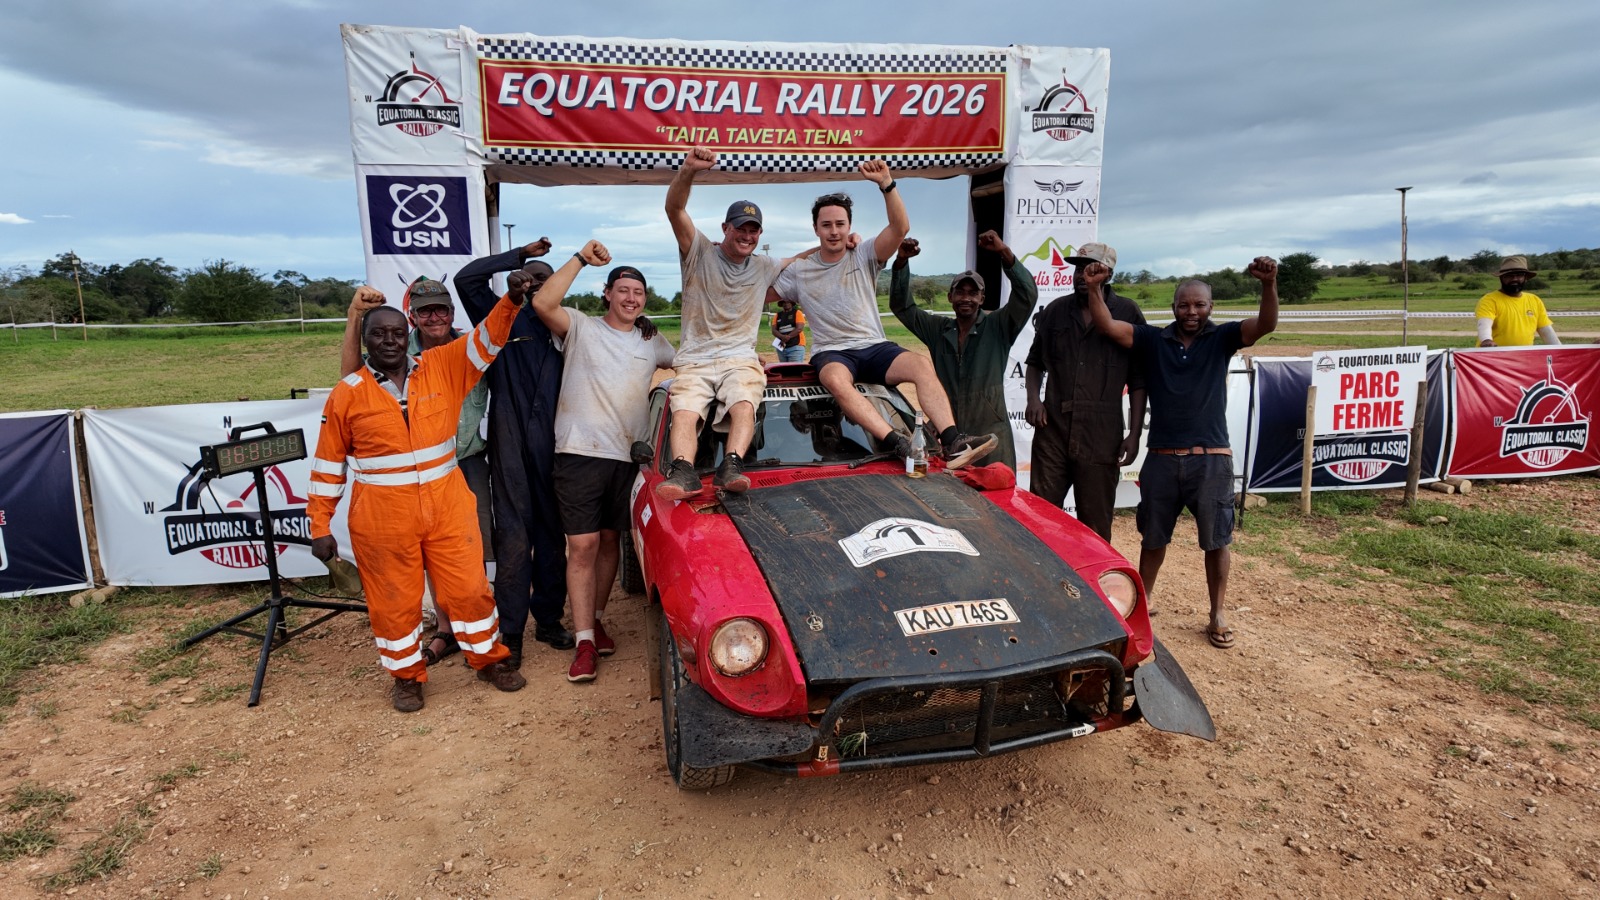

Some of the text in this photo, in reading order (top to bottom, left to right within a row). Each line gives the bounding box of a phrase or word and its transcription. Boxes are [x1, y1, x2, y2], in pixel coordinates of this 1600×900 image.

[364, 95, 372, 103] W
[498, 72, 987, 116] EQUATORIAL RALLY 2026
[378, 108, 459, 124] EQUATORIAL CLASSIC
[1033, 116, 1094, 130] EQUATORIAL CLASSIC
[402, 123, 439, 136] RALLYING
[726, 128, 798, 144] TAVETA
[1051, 129, 1078, 141] RALLYING
[392, 231, 451, 248] USN
[1338, 354, 1394, 368] EQUATORIAL
[1396, 352, 1421, 365] RALLY
[1340, 370, 1400, 400] PARC
[223, 415, 232, 428] N
[1333, 400, 1404, 431] FERME
[1505, 429, 1586, 451] EQUATORIAL CLASSIC
[1370, 440, 1407, 458] CLASSIC
[1527, 449, 1565, 466] RALLYING
[1337, 461, 1382, 479] RALLYING
[143, 501, 155, 515] W
[167, 516, 312, 550] EQUATORIAL CASSIC
[897, 527, 926, 546] 1
[903, 601, 1009, 632] KAU 746S
[1073, 728, 1087, 736] TOW
